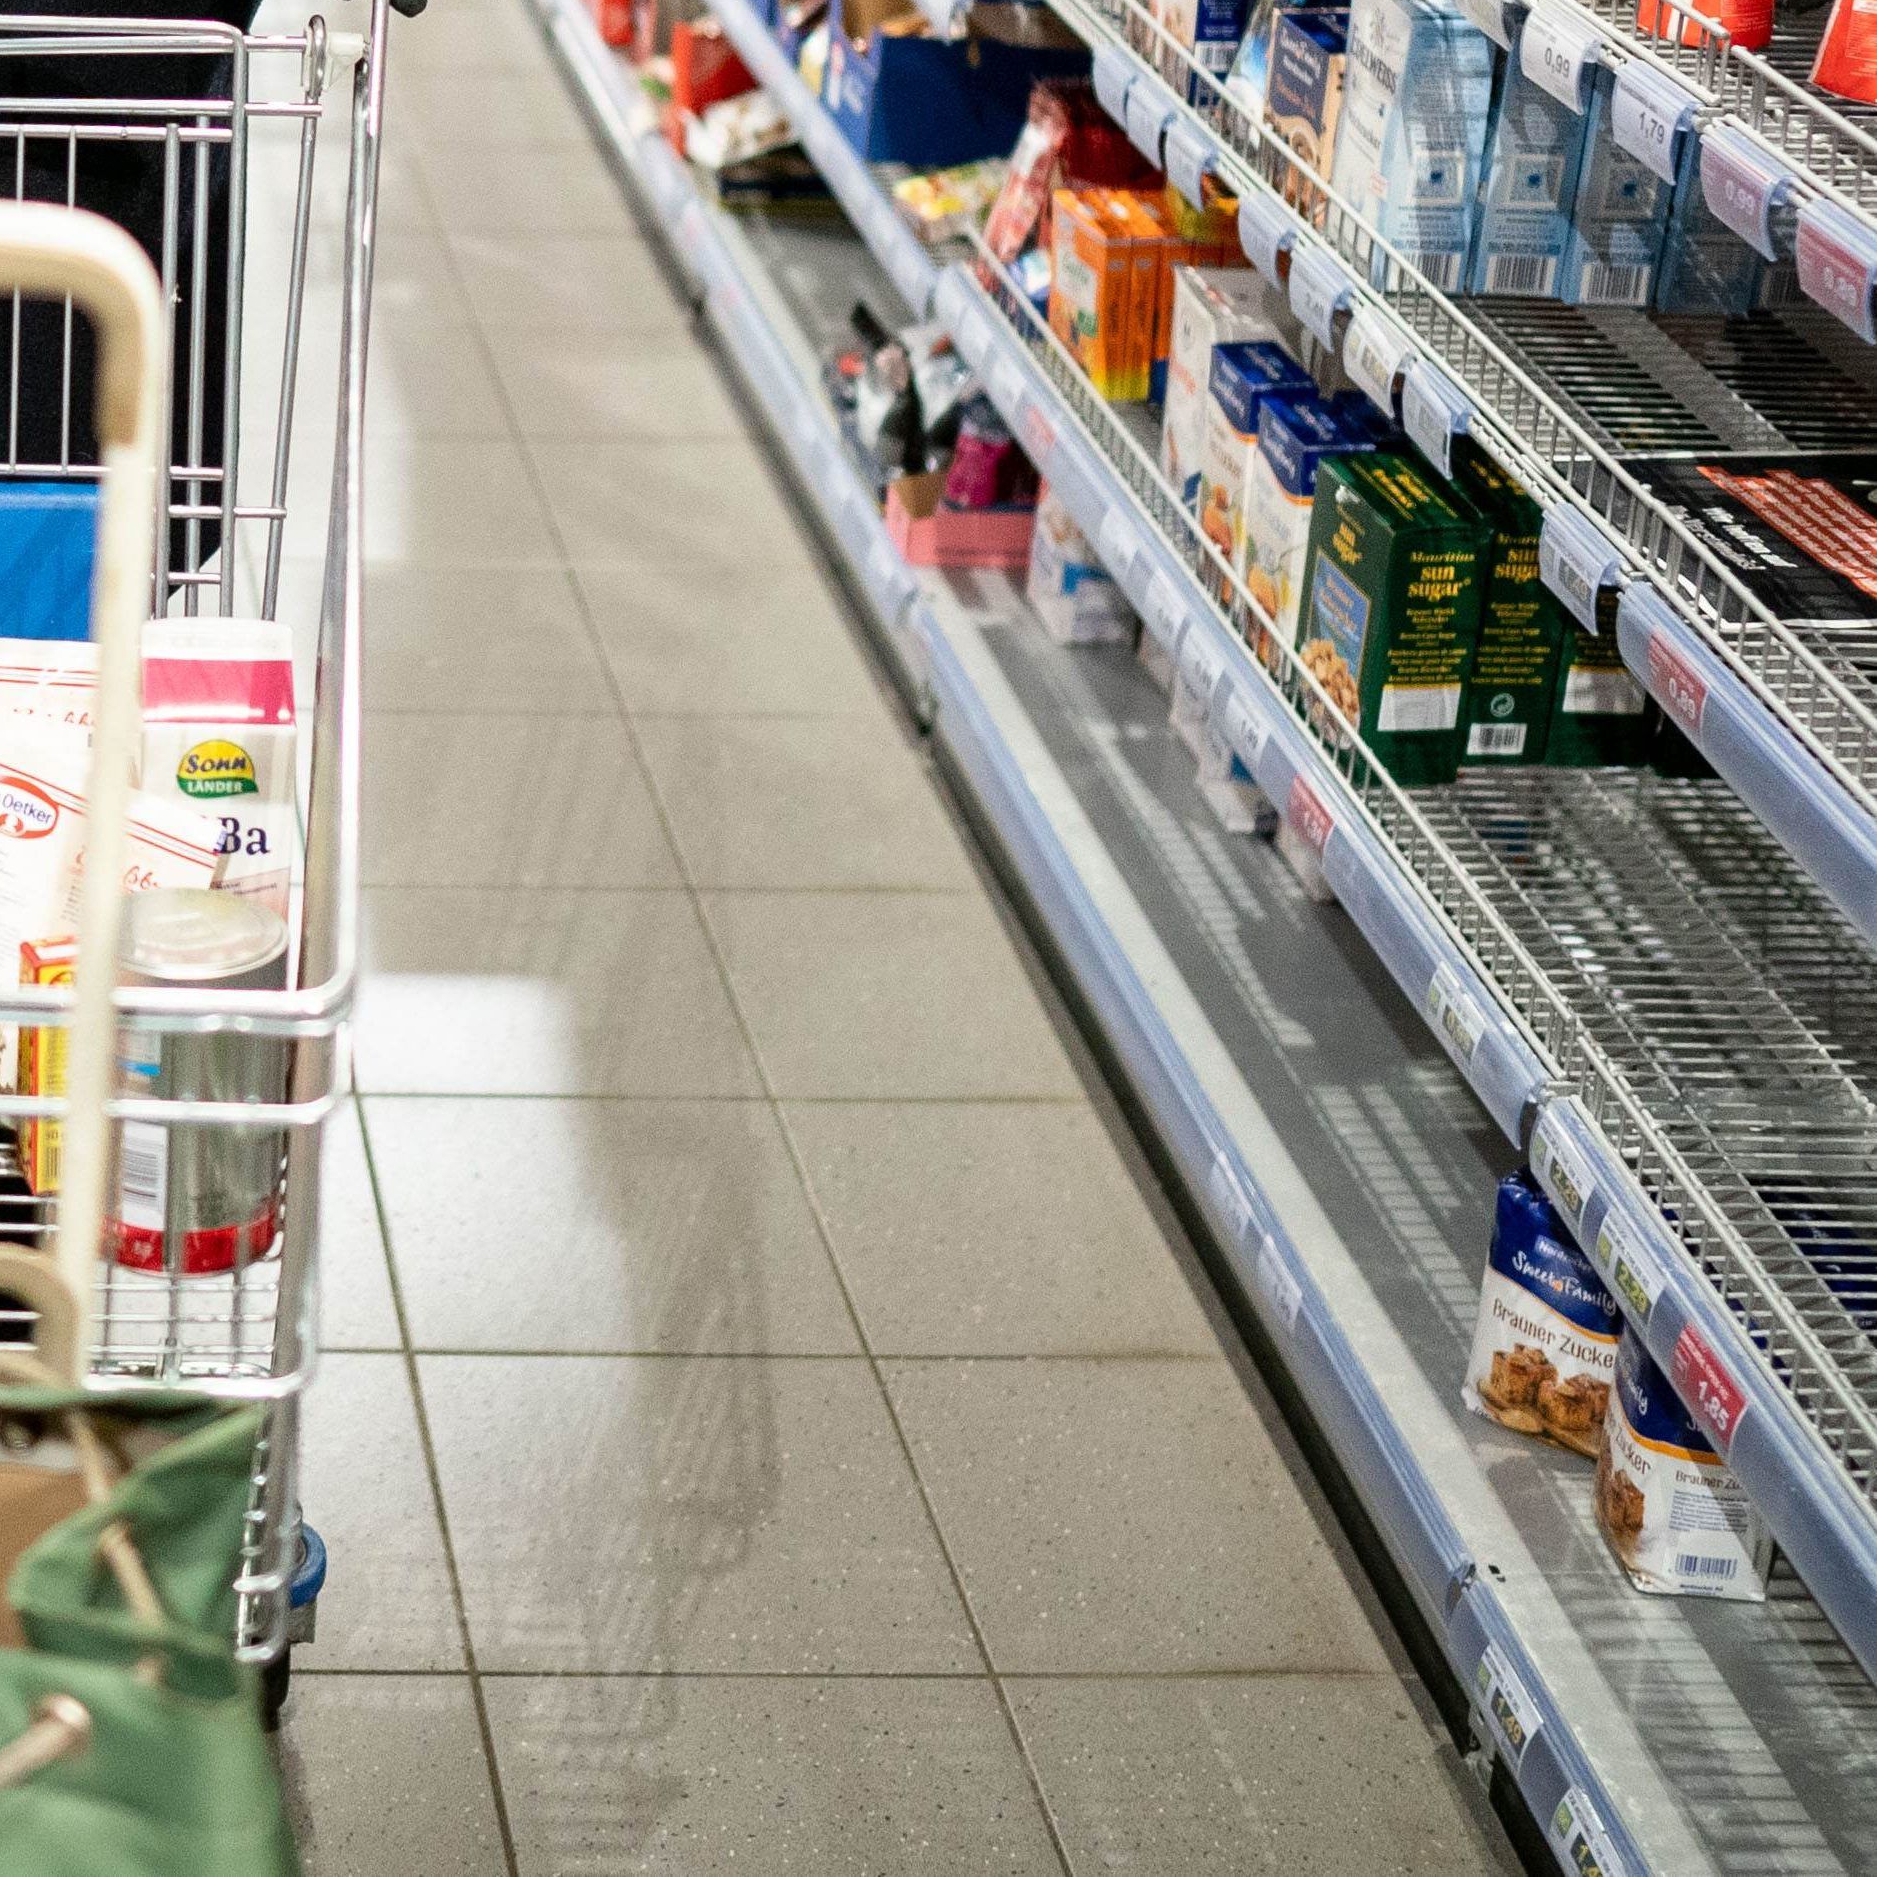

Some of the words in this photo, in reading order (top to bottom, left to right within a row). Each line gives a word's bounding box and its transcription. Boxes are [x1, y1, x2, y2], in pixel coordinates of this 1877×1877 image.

[1545, 47, 1570, 79] 0,99
[1639, 111, 1665, 144] 1,79
[1410, 551, 1475, 562] Mauritius
[1421, 565, 1456, 581] sun
[187, 778, 244, 795] LÄNDER
[2, 794, 53, 826] Oetker
[1512, 1250, 1555, 1287] Sweet
[1562, 1274, 1617, 1317] Family
[1493, 1299, 1556, 1345] Brauner
[1559, 1333, 1616, 1369] Zucke
[1698, 1381, 1729, 1431] 1,85
[1676, 1471, 1720, 1489] Brauner
